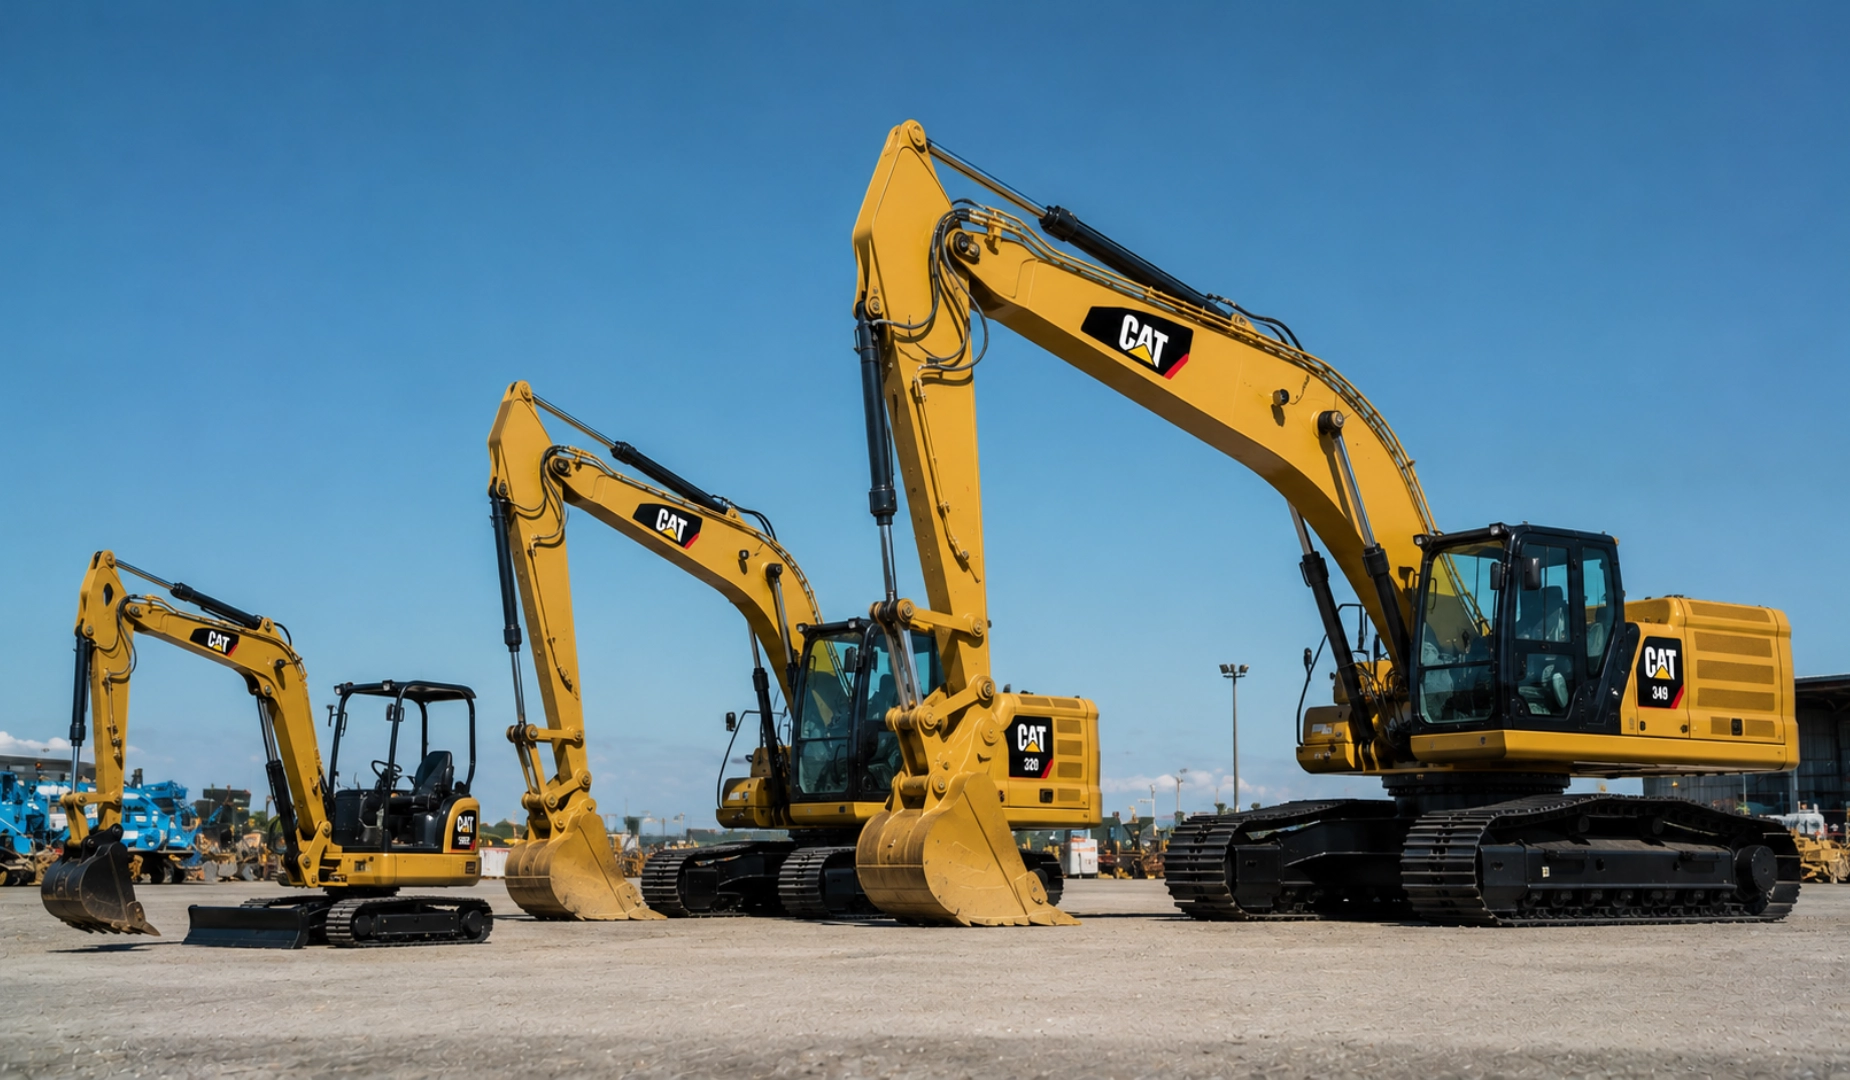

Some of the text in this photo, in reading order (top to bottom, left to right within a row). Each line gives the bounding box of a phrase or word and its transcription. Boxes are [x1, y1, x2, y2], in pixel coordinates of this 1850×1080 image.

[1118, 314, 1170, 367] CAT
[655, 507, 688, 543] CAT
[207, 630, 230, 654] CAT
[1644, 646, 1677, 681] CAT
[1652, 685, 1668, 700] 349
[1017, 723, 1047, 754] CAT
[457, 815, 474, 833] CAT
